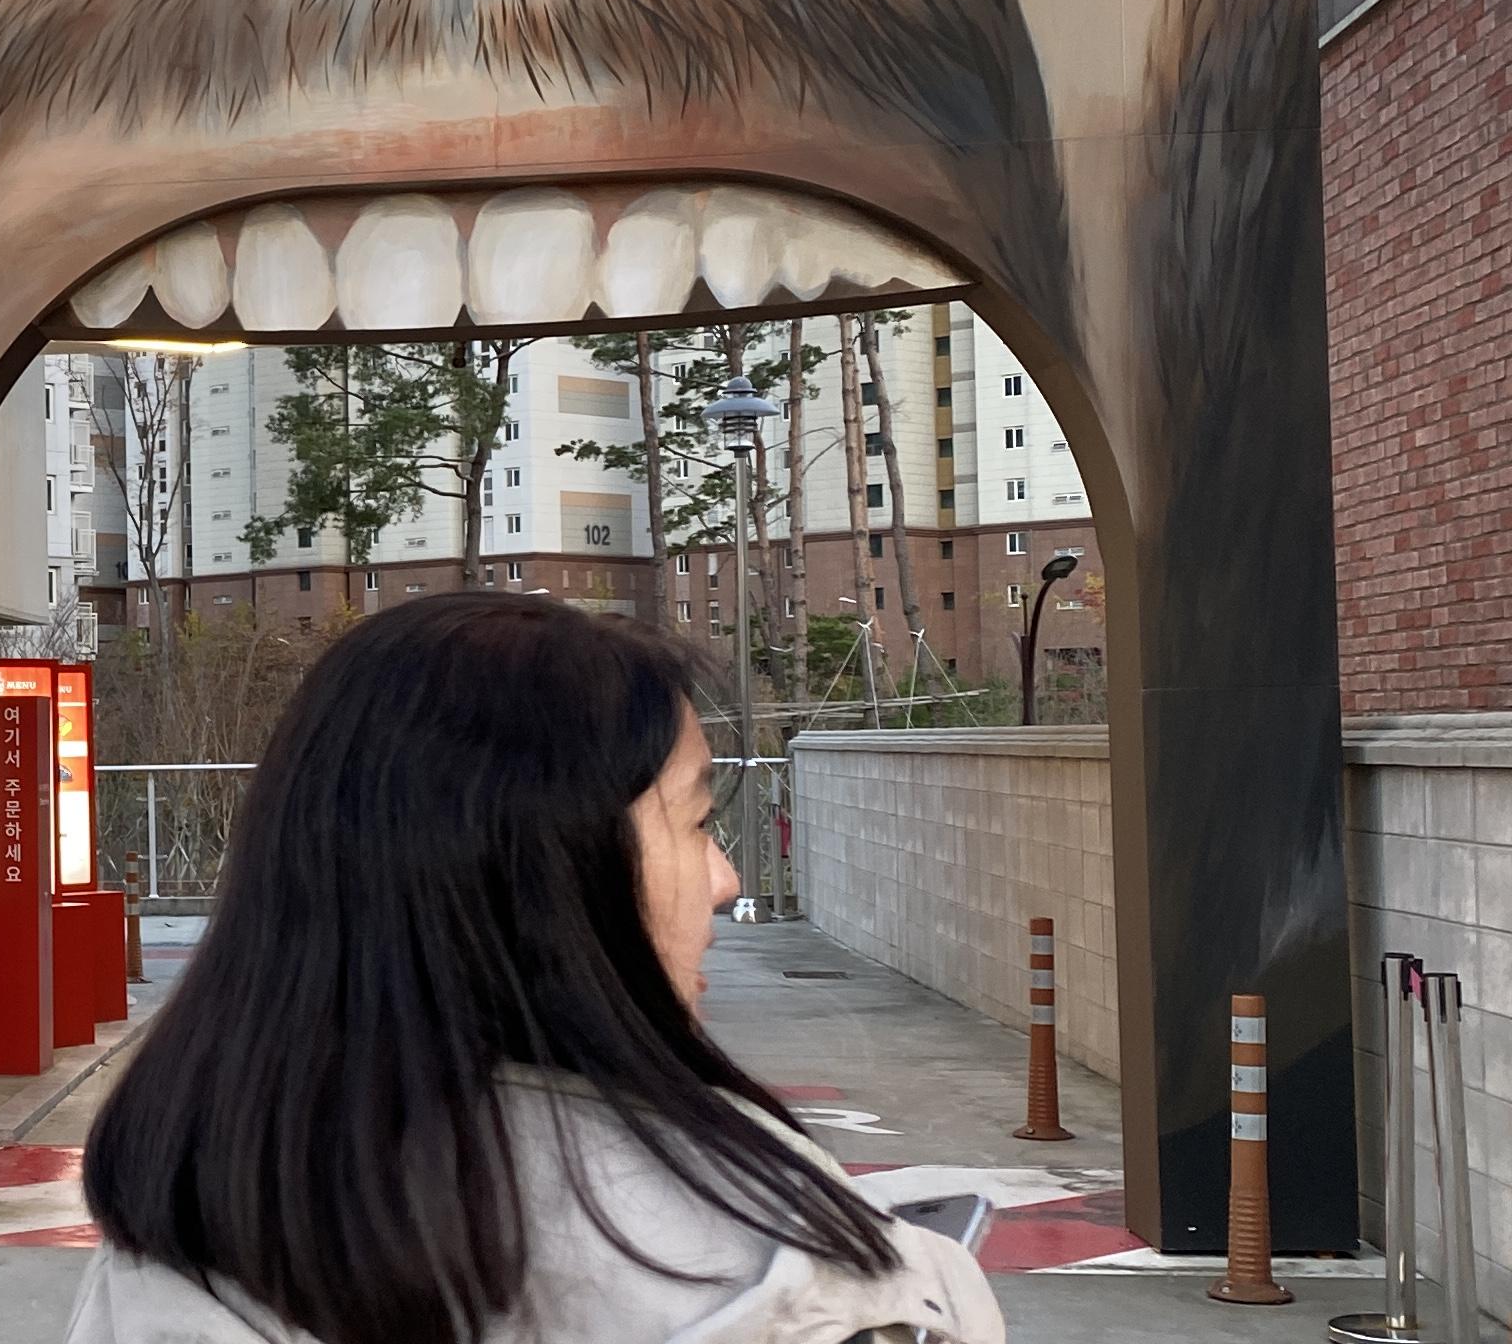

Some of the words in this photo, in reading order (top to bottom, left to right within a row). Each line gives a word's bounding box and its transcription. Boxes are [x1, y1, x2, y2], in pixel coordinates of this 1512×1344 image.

[584, 524, 611, 546] 102
[6, 680, 37, 690] MENU
[4, 706, 20, 768] 여기서
[4, 778, 22, 883] 주문하세요
